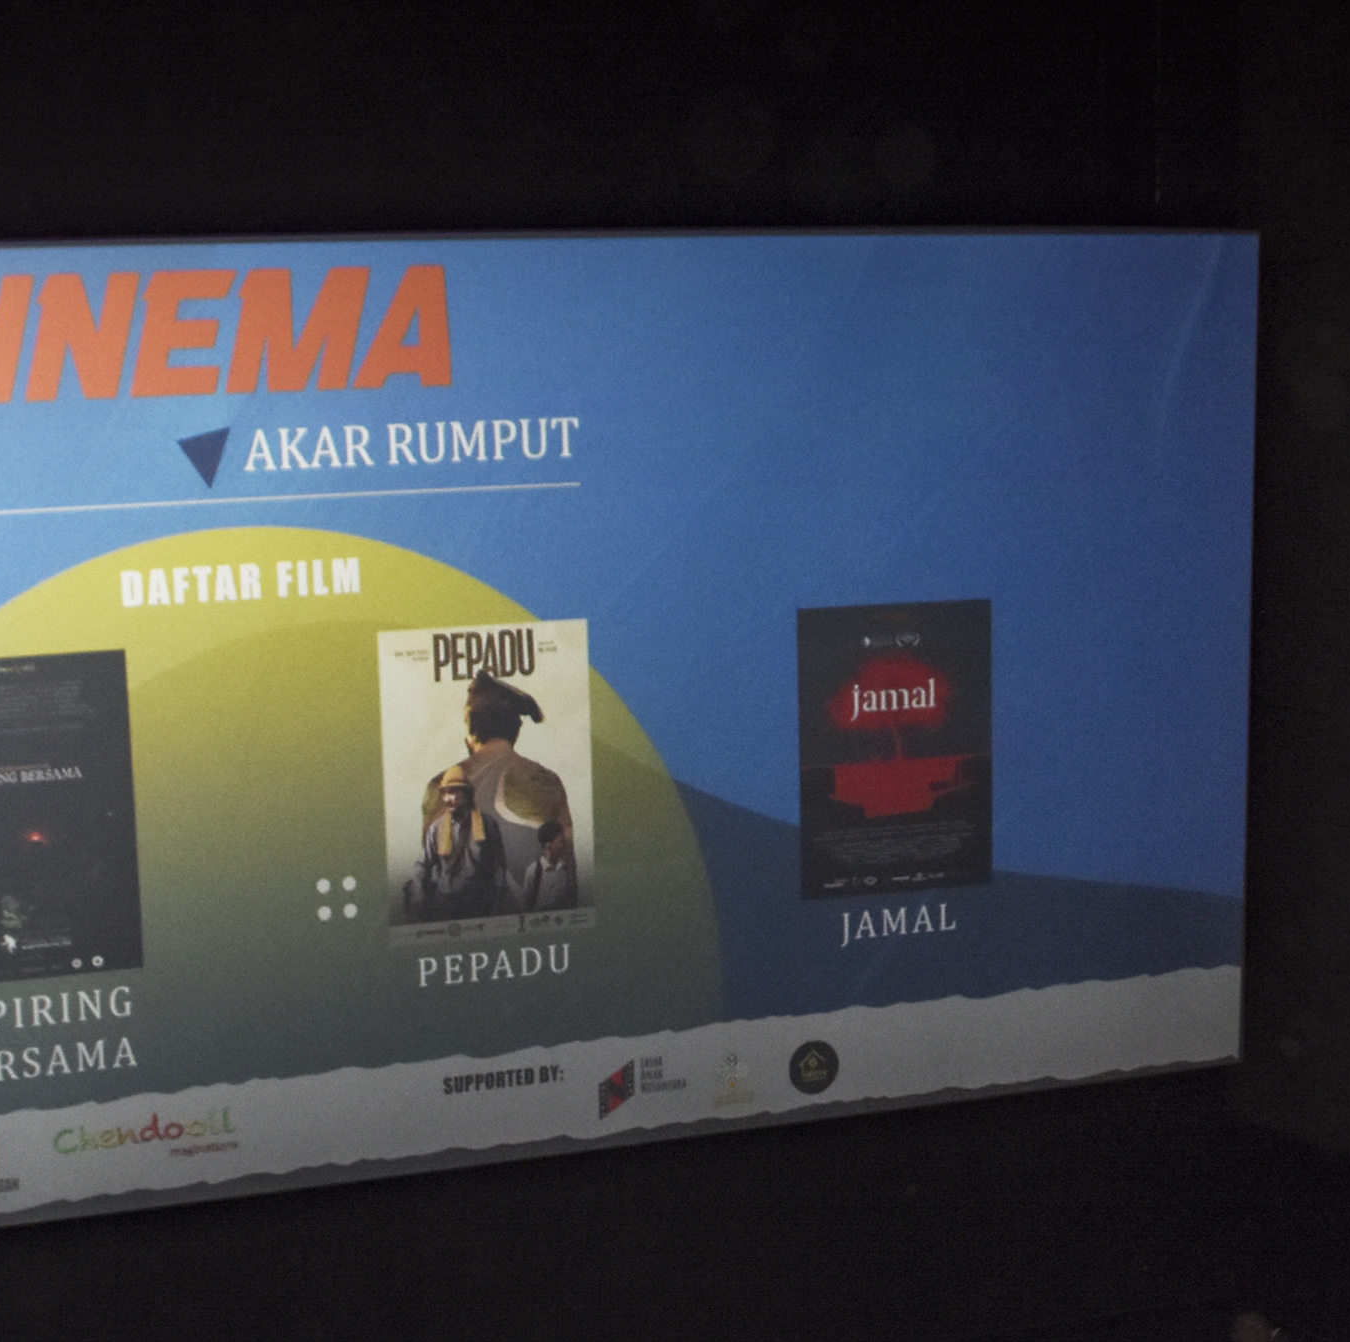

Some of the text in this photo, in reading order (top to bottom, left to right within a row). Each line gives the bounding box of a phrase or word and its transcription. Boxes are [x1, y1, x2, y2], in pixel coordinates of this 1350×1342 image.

[243, 416, 579, 472] AKAR RUMPUT
[120, 556, 362, 608] DAFTAR FILM
[433, 628, 535, 682] PEPADU
[851, 678, 936, 722] jamal
[841, 903, 957, 948] JAMAL
[417, 943, 571, 988] PEPADU
[443, 1065, 565, 1095] SUPPORTED BY:
